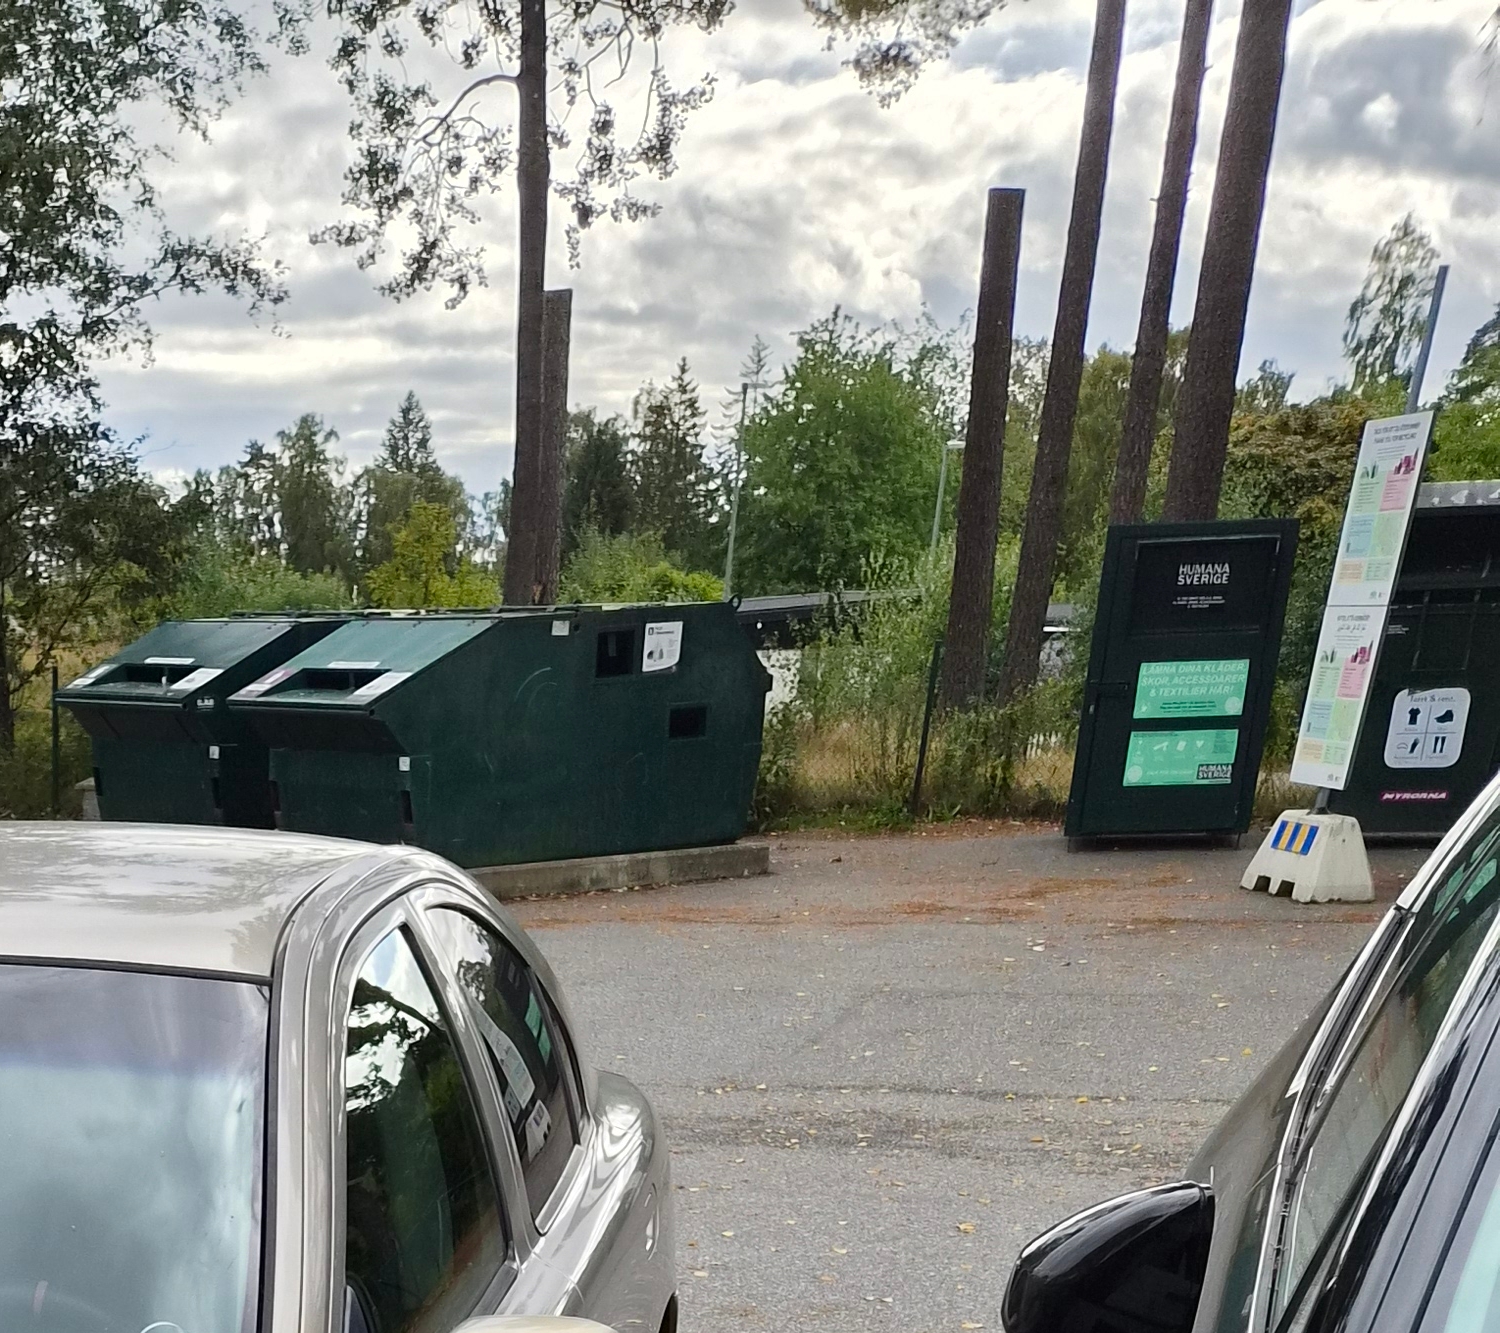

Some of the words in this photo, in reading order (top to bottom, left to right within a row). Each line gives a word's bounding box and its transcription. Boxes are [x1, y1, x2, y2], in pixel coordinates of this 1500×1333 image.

[1179, 563, 1230, 575] HUMANA
[1177, 573, 1230, 585] SVERIGE
[1178, 664, 1202, 674] DINA
[1159, 686, 1207, 697] TEXTILIER
[1199, 764, 1232, 773] HUMANA
[1198, 771, 1232, 779] SVERIGE
[1382, 791, 1447, 800] MYRORNA
